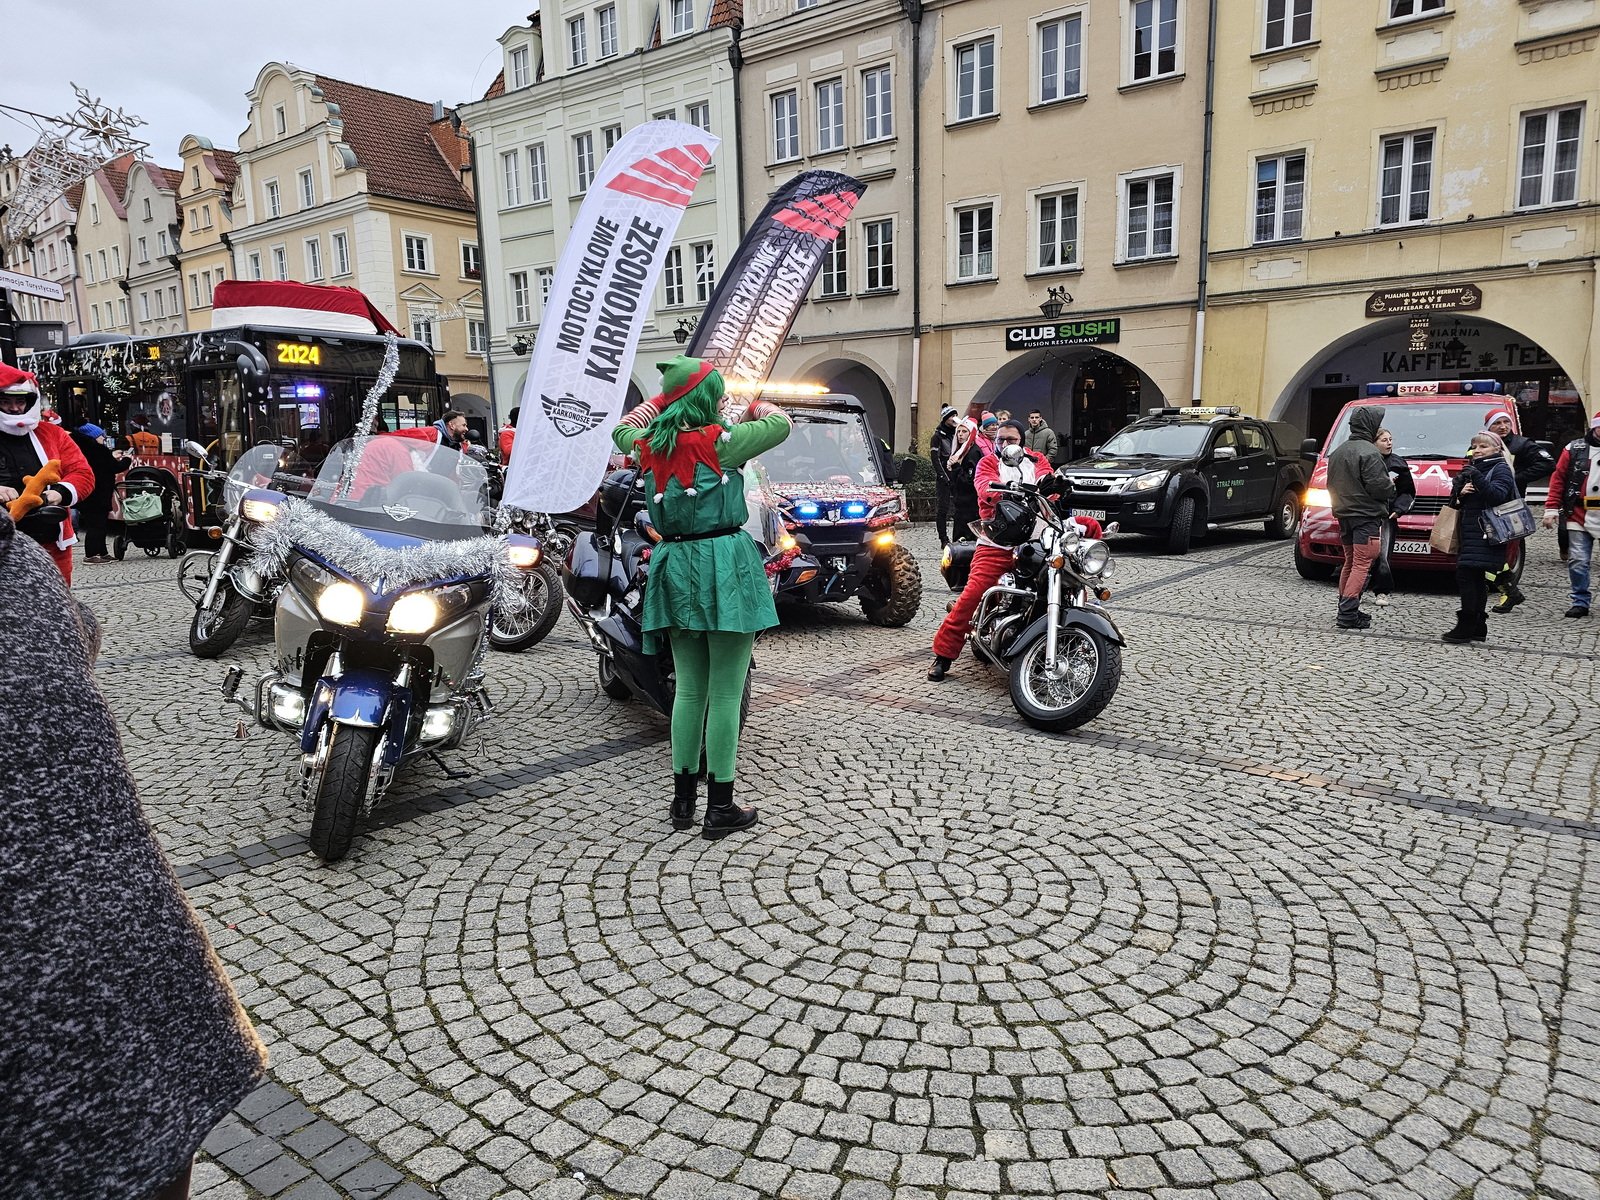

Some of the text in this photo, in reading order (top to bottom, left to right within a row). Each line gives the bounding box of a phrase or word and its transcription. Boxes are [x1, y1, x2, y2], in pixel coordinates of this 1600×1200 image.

[556, 215, 620, 354] MOTOCYKLOWE
[712, 241, 780, 353] MOTOCYKLOWE
[584, 215, 664, 384] KARKONOSZE
[733, 242, 816, 383] KARKONOSZE
[1009, 321, 1115, 342] CLUB SUSHI
[1051, 336, 1099, 345] RESTAURANT
[277, 343, 321, 366] 2024
[1382, 343, 1552, 373] KAFFEE TEE
[1399, 384, 1437, 393] STRAŻ
[552, 407, 591, 425] KARKONOSZE
